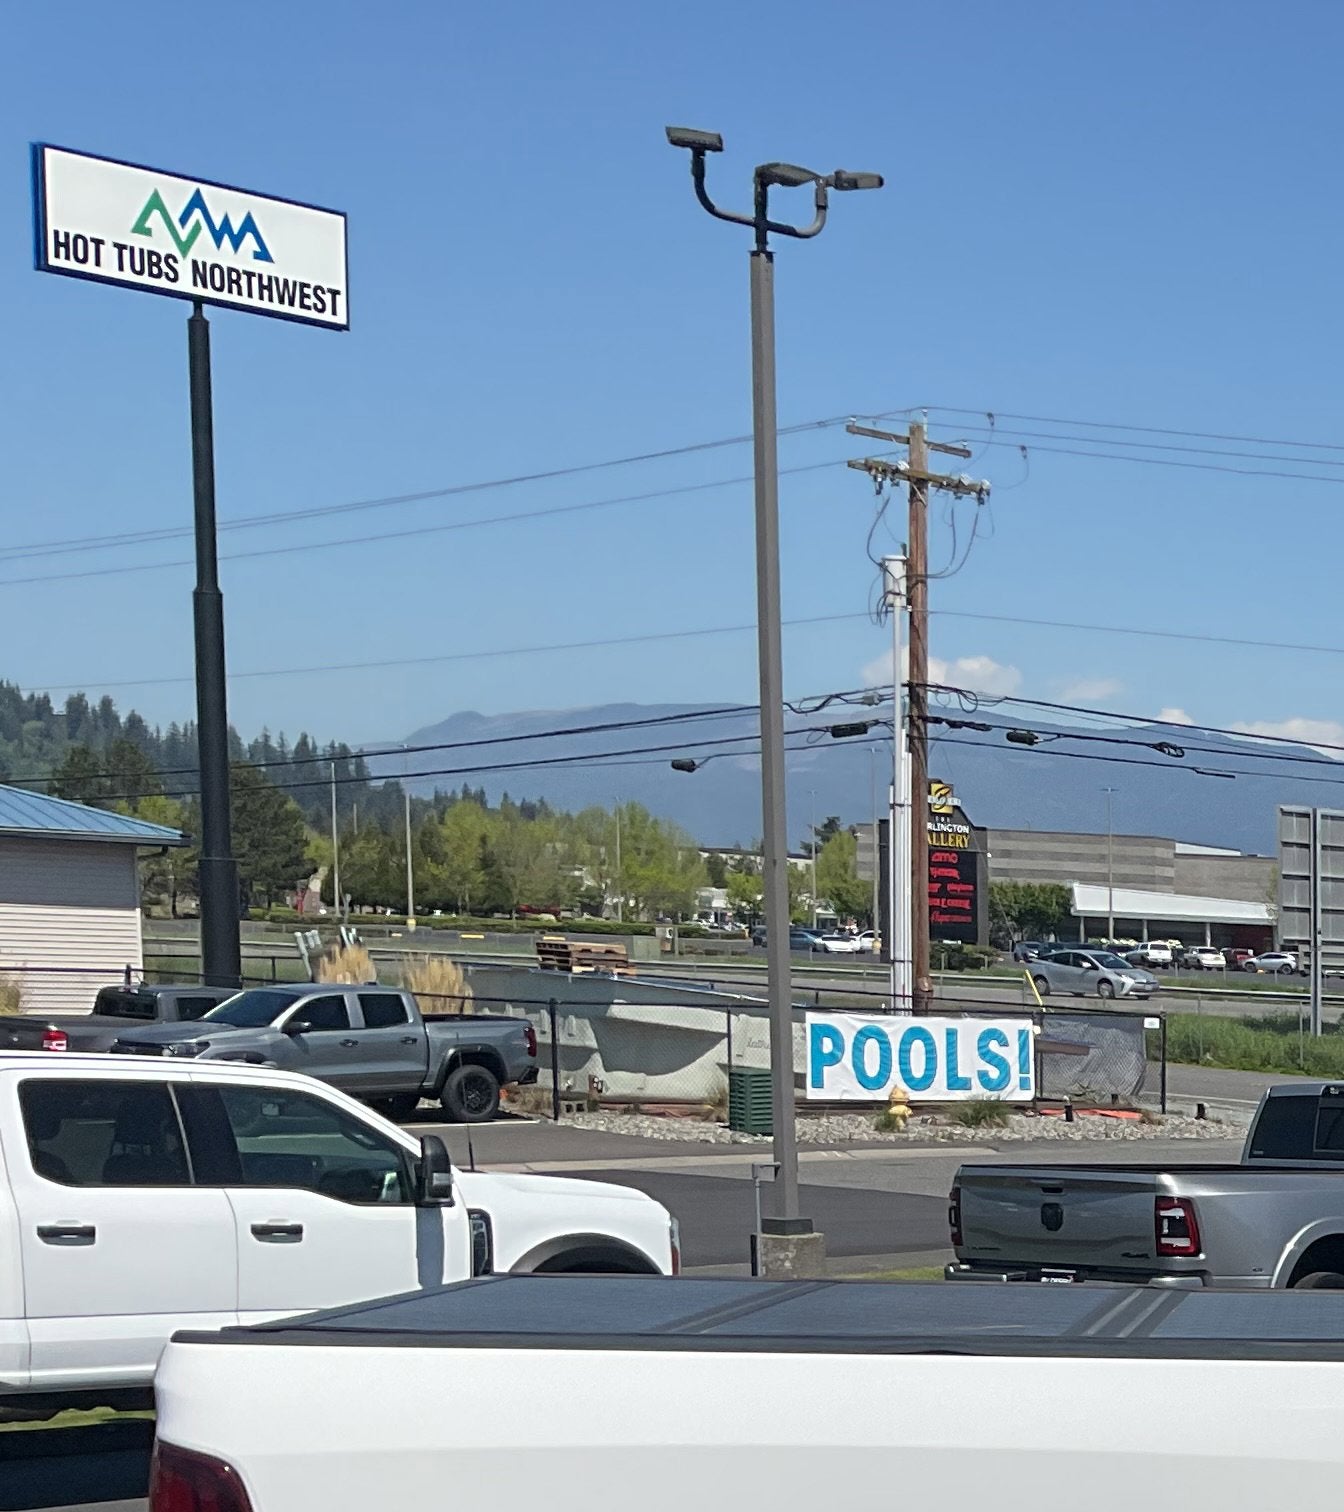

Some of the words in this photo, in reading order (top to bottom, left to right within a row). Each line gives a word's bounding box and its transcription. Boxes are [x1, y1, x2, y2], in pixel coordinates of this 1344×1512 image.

[54, 229, 105, 267] HOT
[113, 241, 179, 283] TUBS
[192, 258, 341, 317] NORTHWEST
[927, 821, 969, 834] RLINGTON
[928, 832, 970, 848] ALLERY
[810, 1023, 1032, 1092] POOLS!
